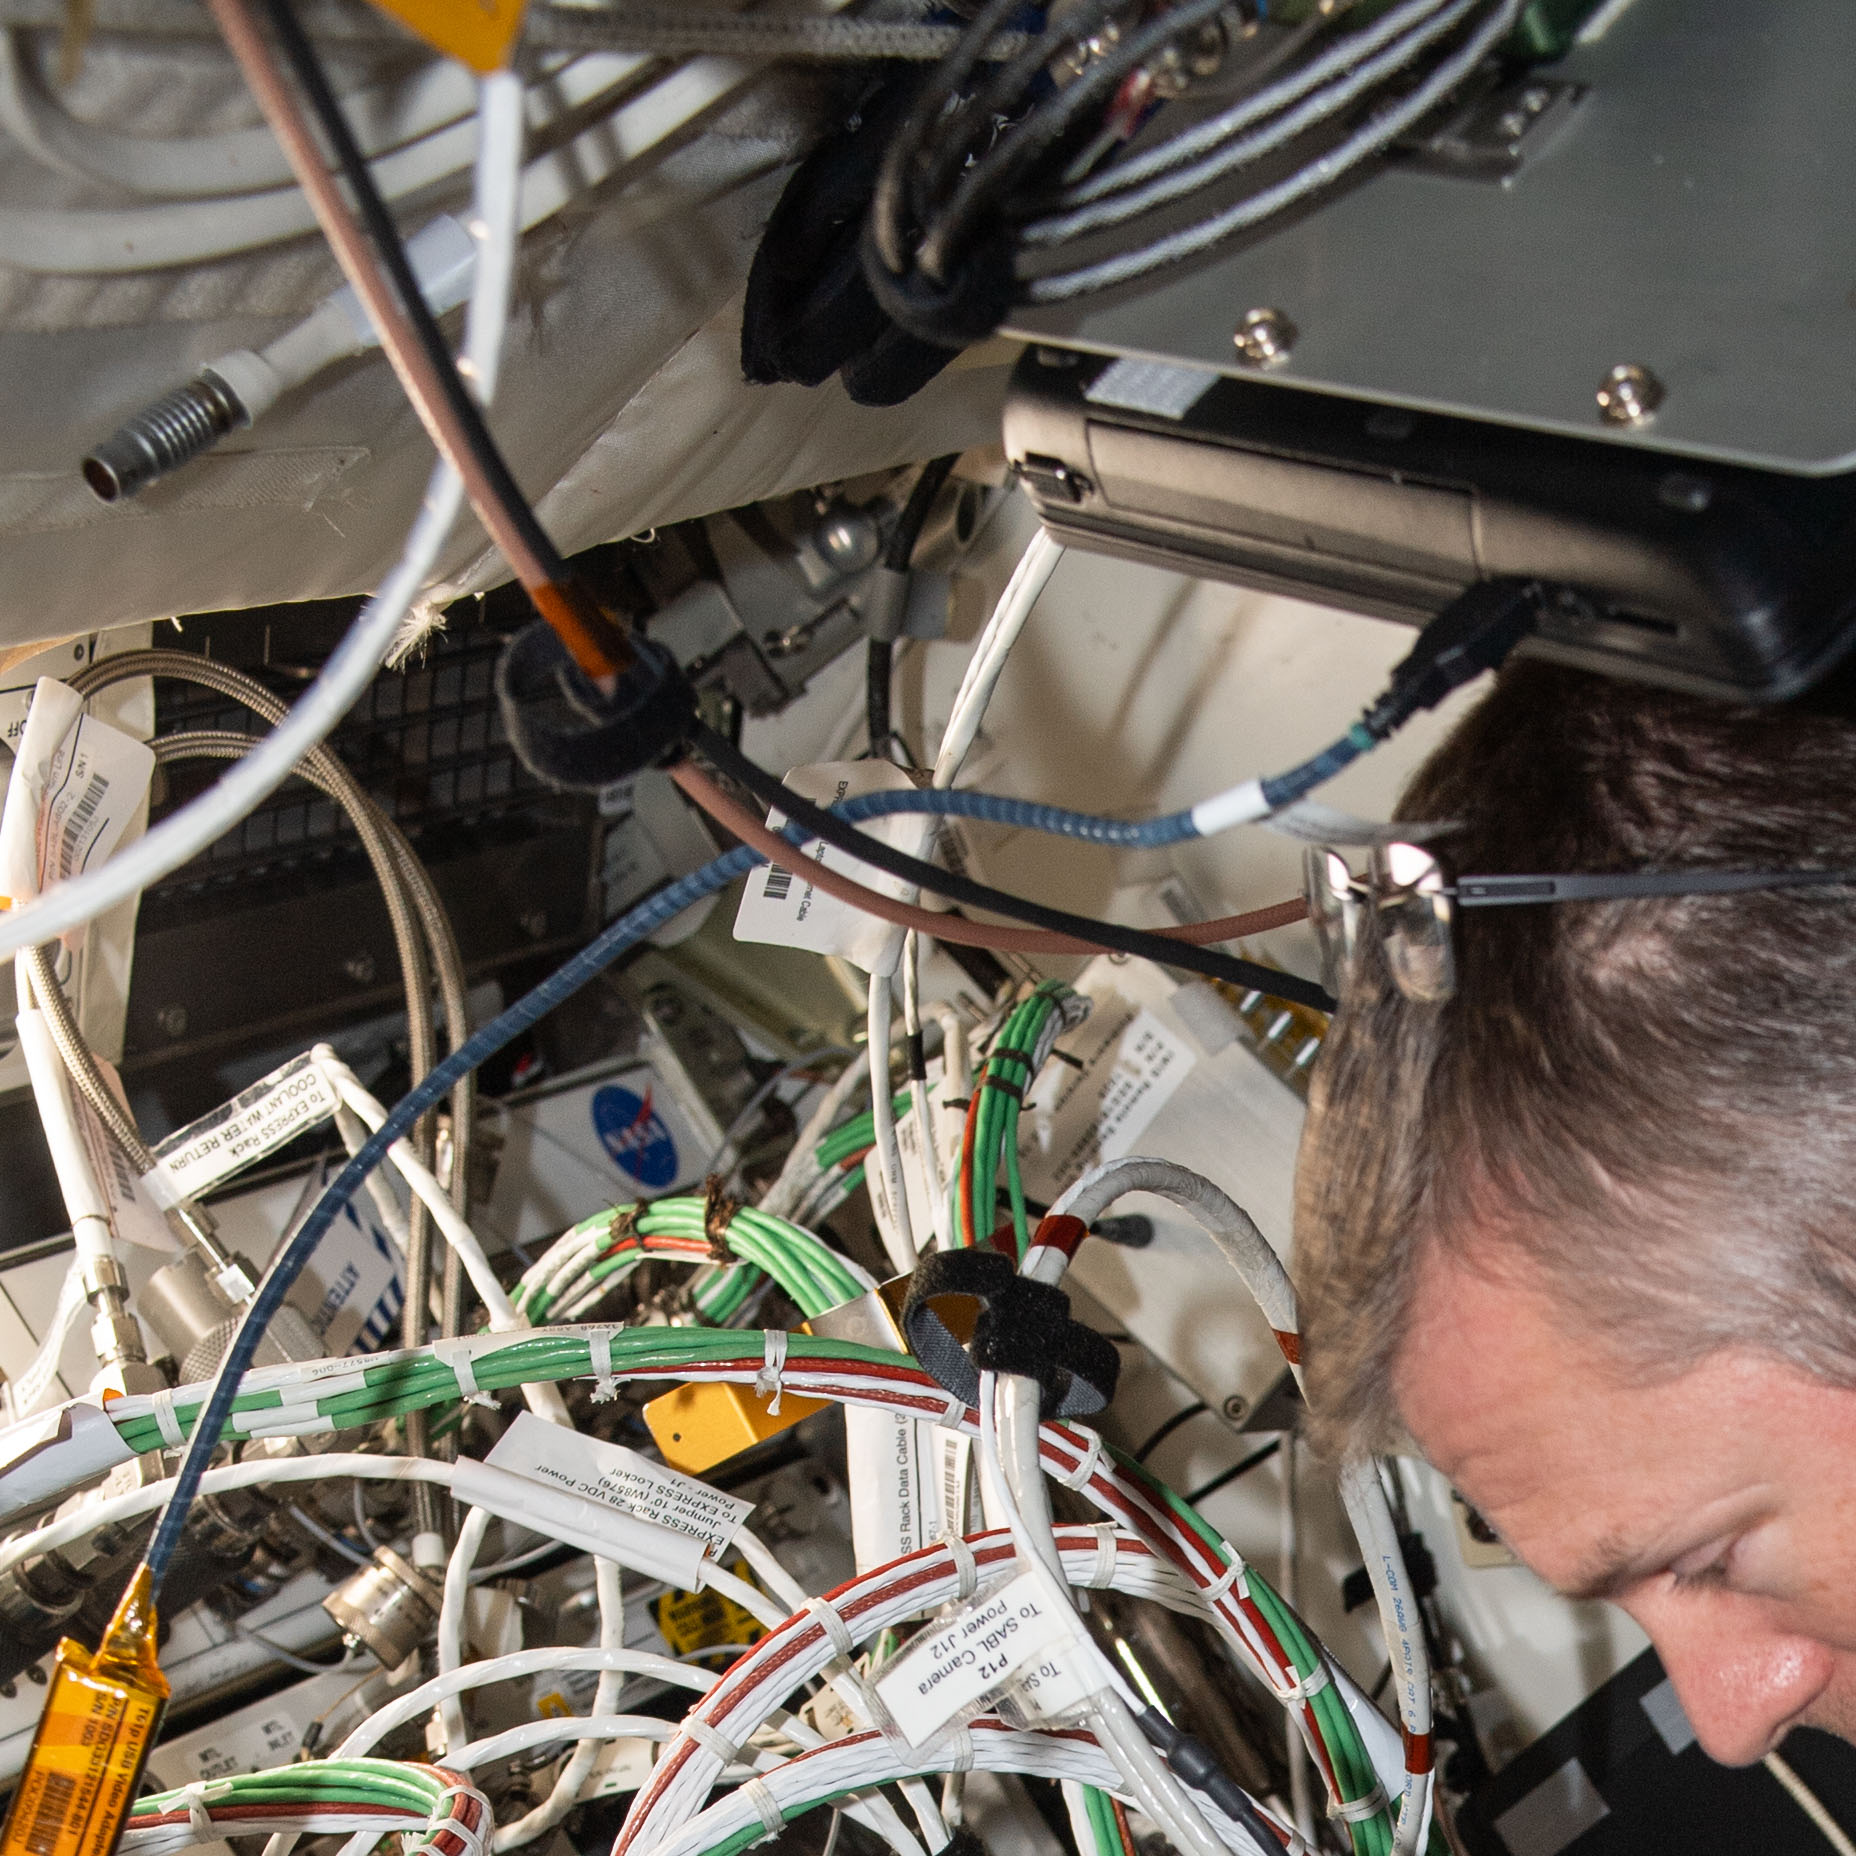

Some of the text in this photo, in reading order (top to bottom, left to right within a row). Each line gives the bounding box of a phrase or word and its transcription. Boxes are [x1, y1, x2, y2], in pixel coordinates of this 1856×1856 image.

[796, 899, 814, 922] Cable
[168, 1074, 319, 1170] COOLANT WATER RETURN
[230, 1091, 325, 1159] To EXPRESS Rack
[612, 1468, 736, 1523] To EXPRESS Locker
[669, 1476, 735, 1509] Power J1
[895, 1427, 912, 1532] Rack Data Cable
[537, 1464, 724, 1545] EXPRESS Rack 28 VDC Power
[674, 1506, 721, 1528] Jumper
[919, 1602, 1040, 1694] To SABL Camera
[931, 1601, 1007, 1659] Power J12
[979, 1654, 1008, 1679] P12
[1040, 1663, 1059, 1679] To
[118, 1739, 138, 1771] USB
[105, 1770, 128, 1810] Video
